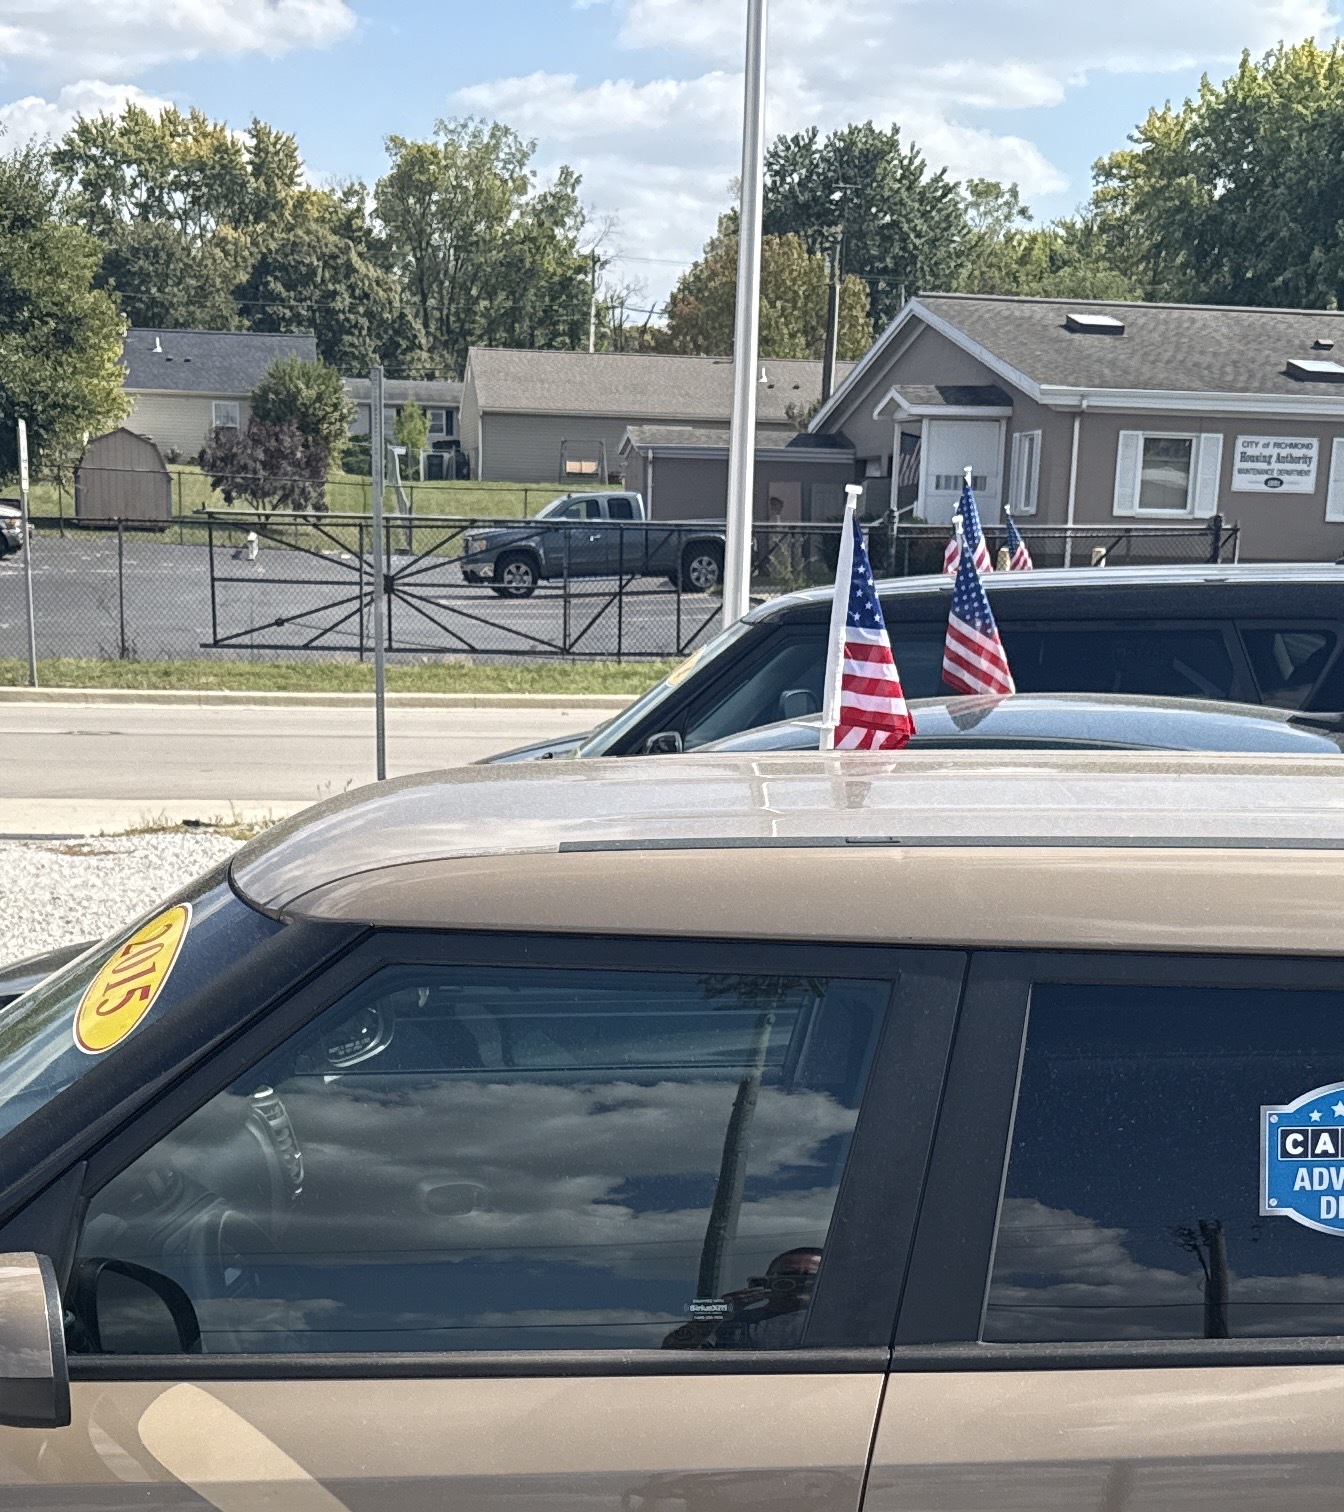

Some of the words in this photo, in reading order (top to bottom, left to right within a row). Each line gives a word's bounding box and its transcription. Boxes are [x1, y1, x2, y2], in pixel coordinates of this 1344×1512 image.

[1242, 440, 1259, 449] CITY
[1272, 442, 1313, 450] RICHMOND
[1239, 451, 1273, 466] Housing
[1275, 453, 1313, 467] Authority
[96, 923, 173, 1017] 2015
